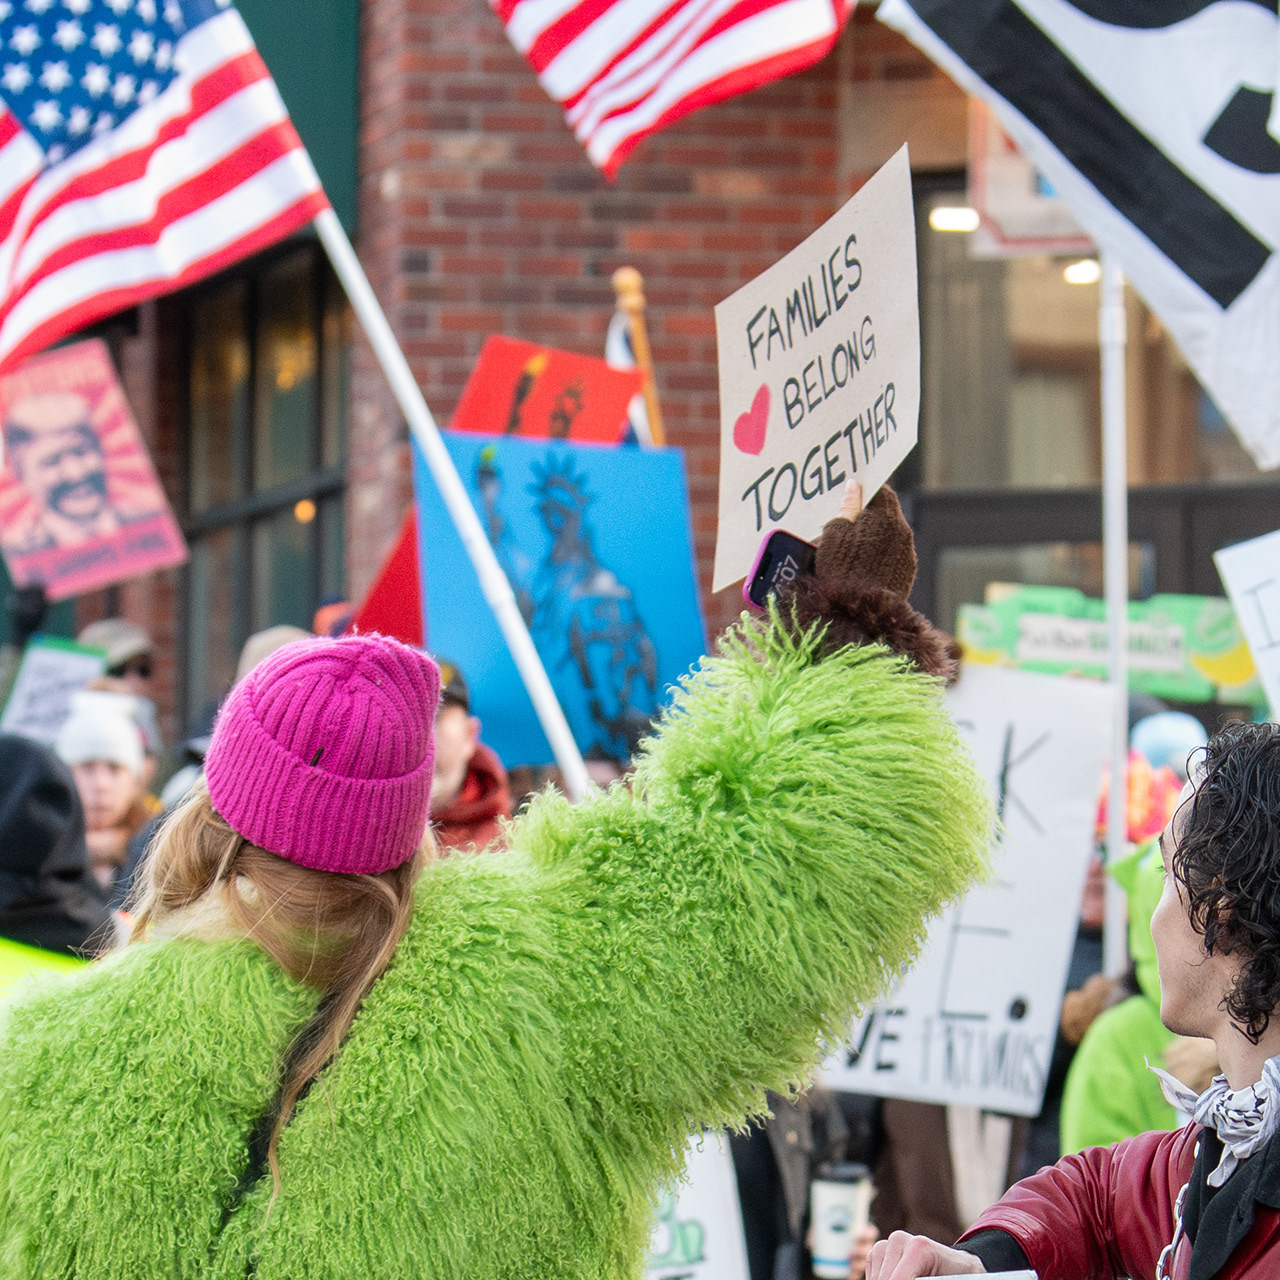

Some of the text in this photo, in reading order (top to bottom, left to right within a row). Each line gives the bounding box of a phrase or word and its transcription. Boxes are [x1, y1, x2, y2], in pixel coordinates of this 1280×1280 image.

[746, 233, 863, 370] FAMILIES
[782, 314, 877, 430] BELONG
[741, 381, 898, 532] TOGETHER
